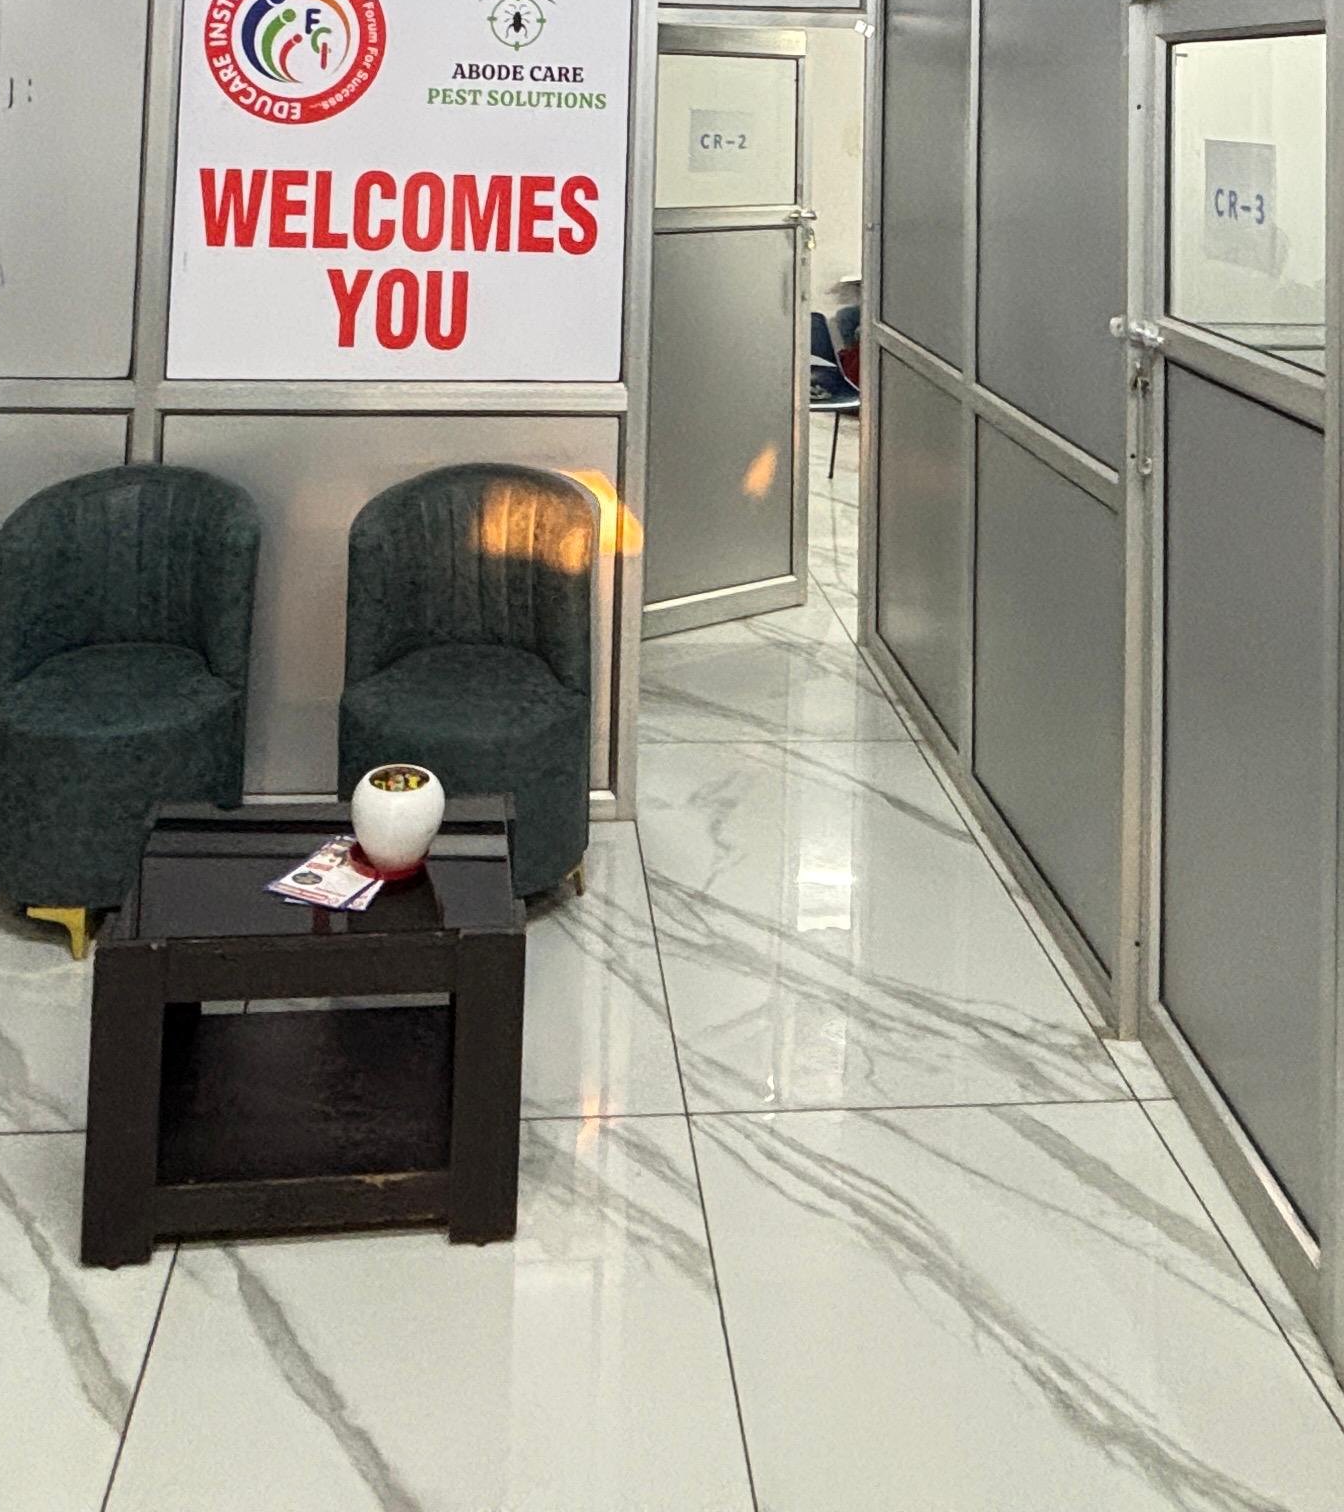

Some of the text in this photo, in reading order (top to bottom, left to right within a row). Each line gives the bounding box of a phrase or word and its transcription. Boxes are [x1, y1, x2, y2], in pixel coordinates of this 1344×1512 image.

[362, 1, 379, 44] Forum
[363, 45, 379, 69] For
[452, 63, 584, 84] ABODE CARE
[212, 53, 301, 120] EDUCARE
[427, 87, 607, 110] PEST SOLUTIONS
[700, 133, 747, 149] CR-2
[199, 167, 599, 255] WELCOMES
[1215, 188, 1265, 225] CR-3
[327, 268, 469, 351] YOU
